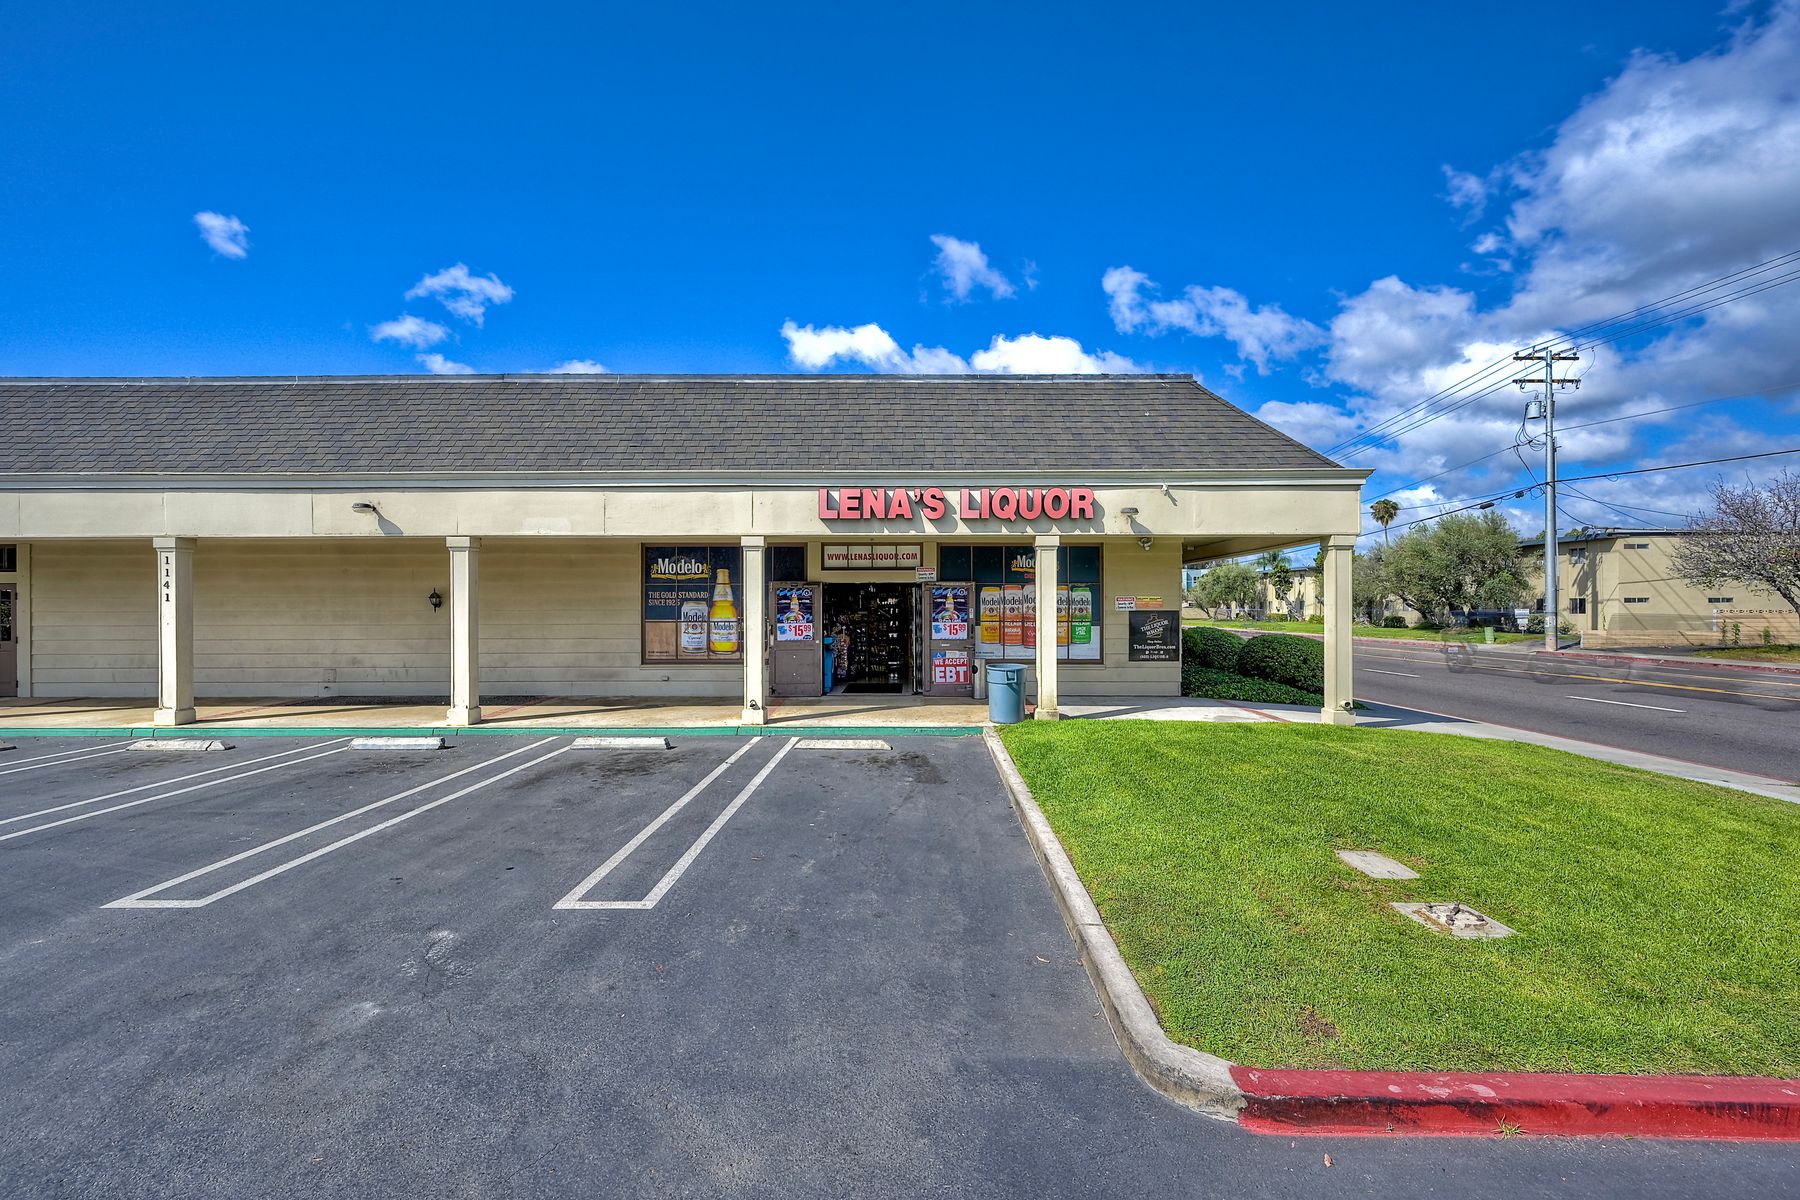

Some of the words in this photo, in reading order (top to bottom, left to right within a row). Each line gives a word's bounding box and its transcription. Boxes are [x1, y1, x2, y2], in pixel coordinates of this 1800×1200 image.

[818, 487, 945, 520] LENA'S
[959, 487, 1094, 522] LIQUOR
[827, 552, 918, 561] WWW.LENASLIQUOR.COM
[658, 558, 702, 574] Modelo
[163, 555, 171, 602] 1141
[648, 591, 660, 599] THE
[660, 591, 677, 599] GOLD
[678, 591, 709, 599] STANDARD
[935, 666, 967, 682] EBT
